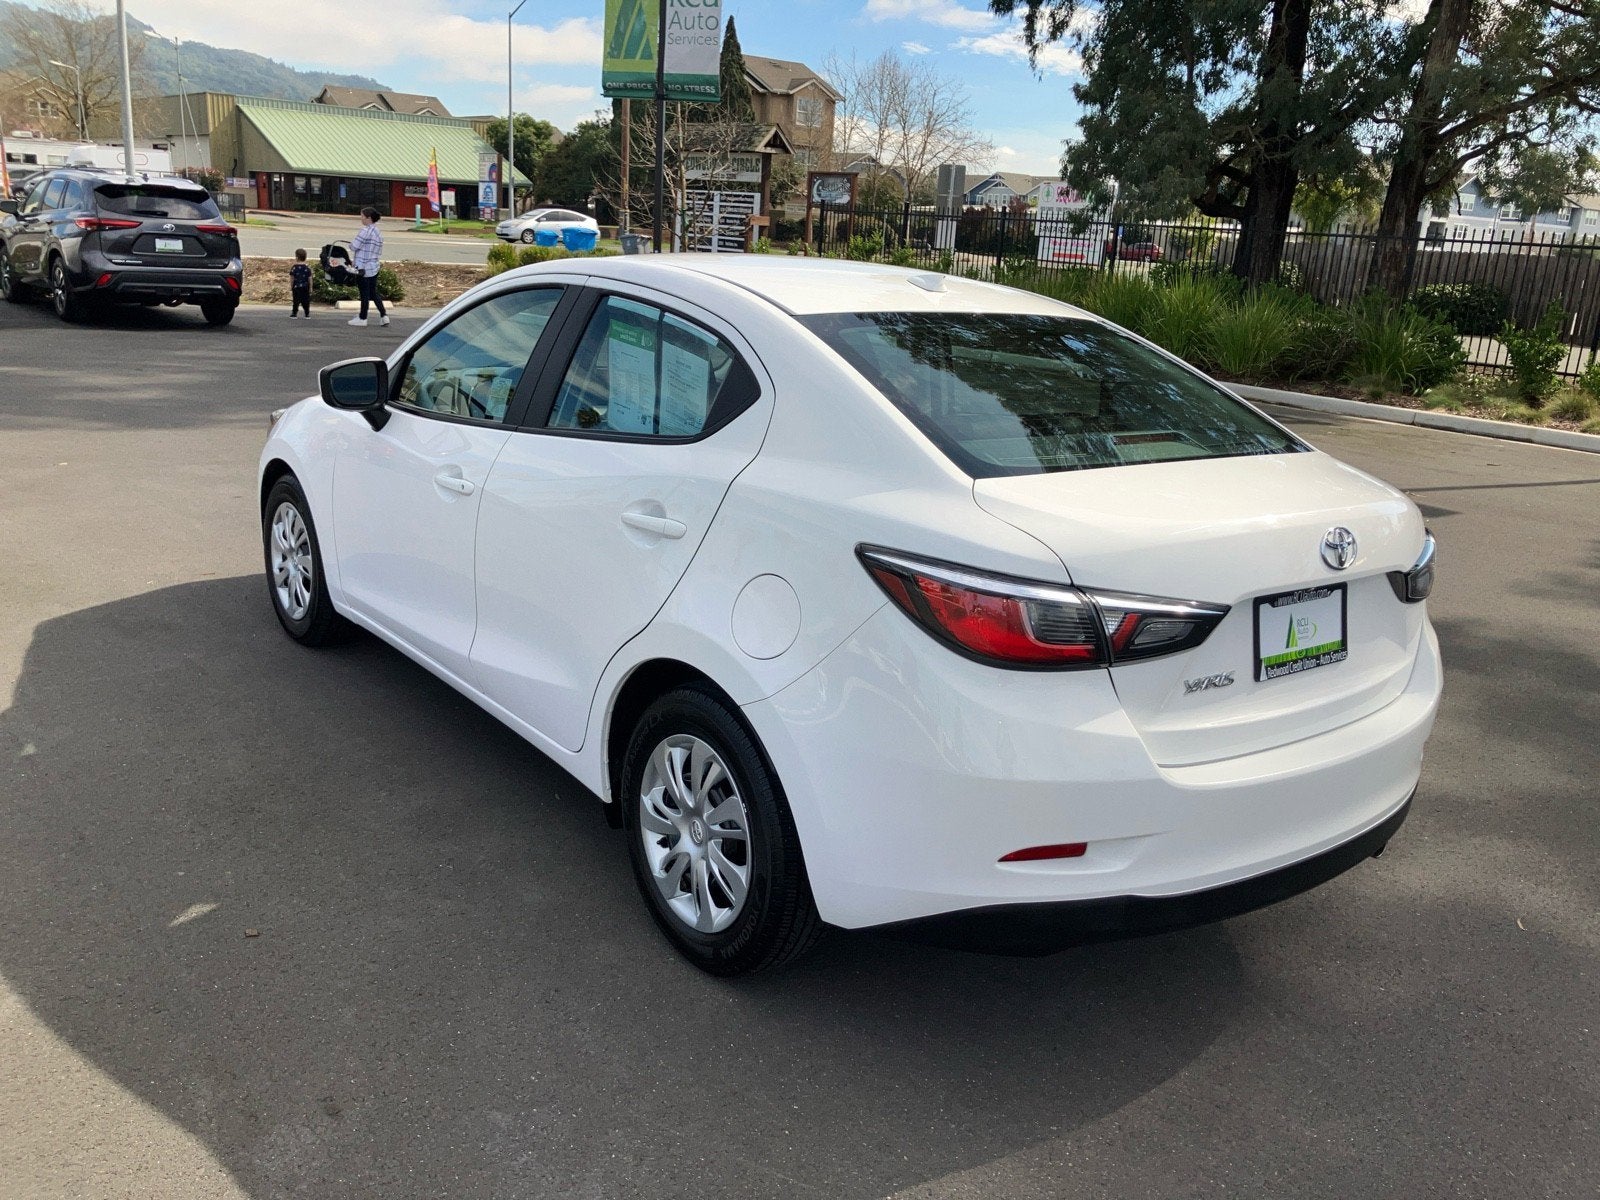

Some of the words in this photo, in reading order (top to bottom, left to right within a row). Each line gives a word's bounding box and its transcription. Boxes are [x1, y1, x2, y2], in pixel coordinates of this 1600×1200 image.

[668, 10, 719, 31] Auto
[667, 32, 718, 46] Services
[626, 82, 653, 90] PRICE
[684, 84, 716, 94] STRESS
[731, 156, 760, 172] CIRCLE
[1267, 663, 1289, 678] Redwood
[1289, 659, 1303, 673] Credit
[1303, 657, 1317, 670] Union
[1319, 654, 1330, 665] Auto
[1330, 650, 1347, 663] Services
[1183, 671, 1235, 695] YARIS
[720, 907, 760, 960] YOKOHAMA
